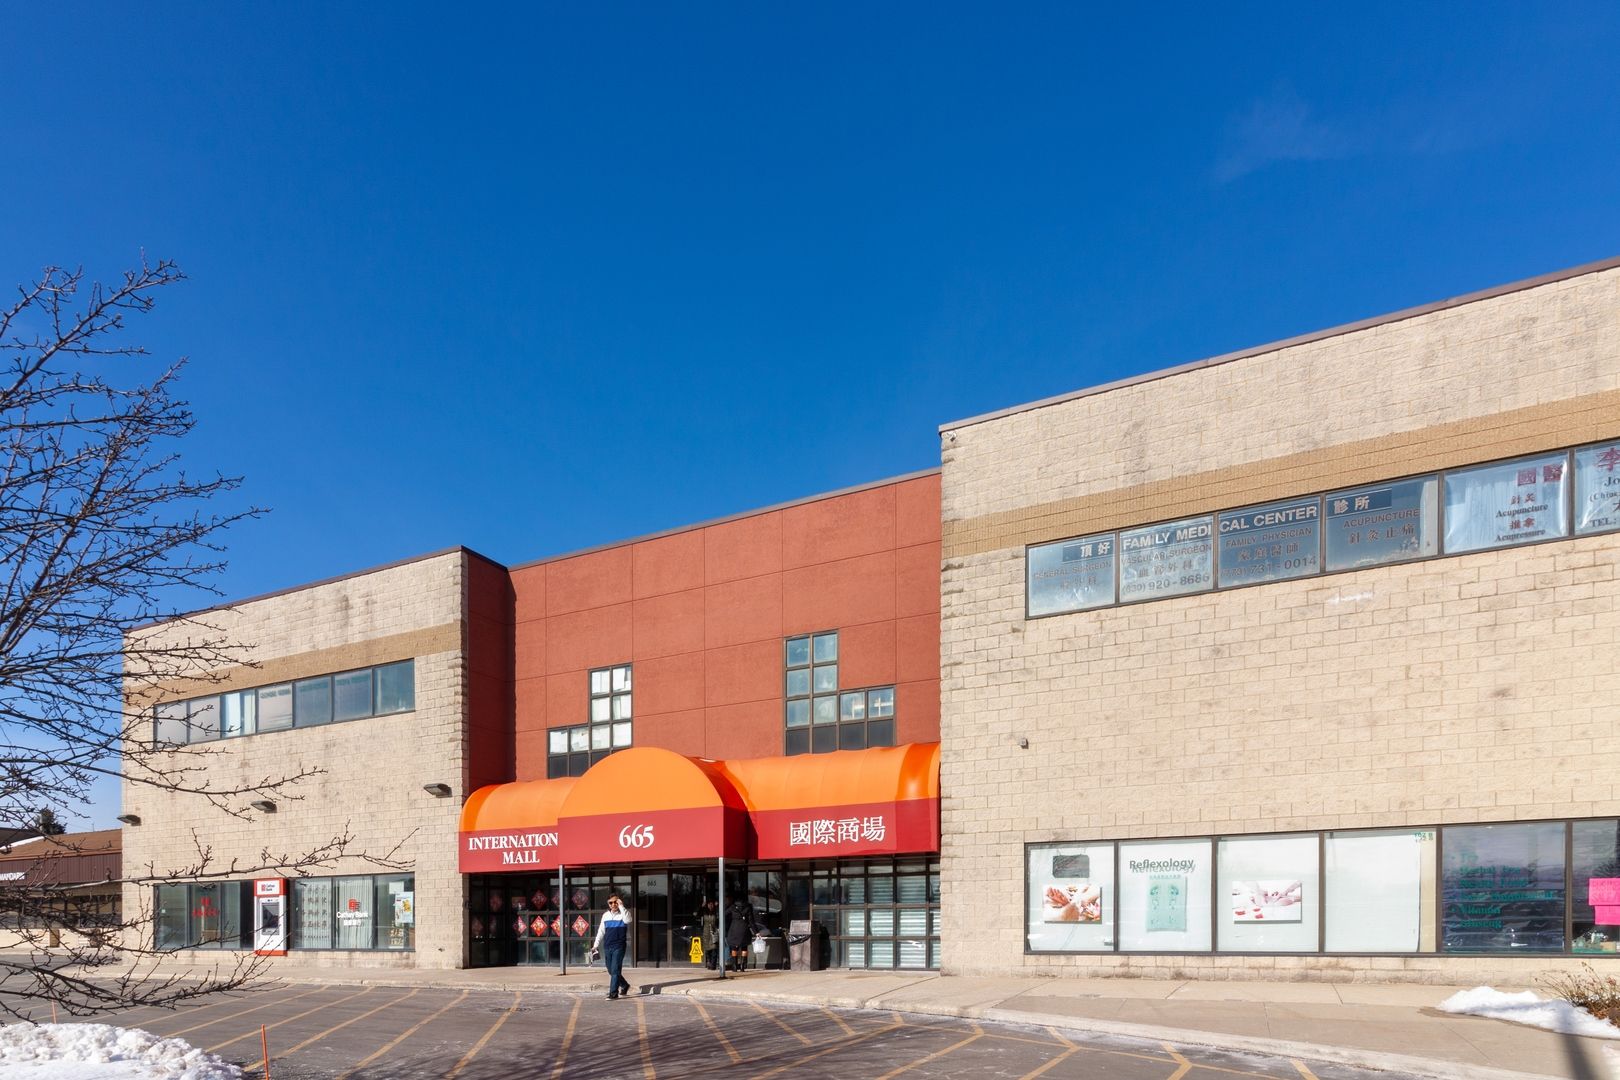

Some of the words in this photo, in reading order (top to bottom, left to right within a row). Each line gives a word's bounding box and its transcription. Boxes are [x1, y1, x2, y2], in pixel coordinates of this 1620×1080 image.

[1343, 508, 1420, 529] ACUPUNCTURE
[1496, 503, 1549, 518] Acupuncture
[1122, 532, 1170, 551] FAMILY
[1253, 505, 1317, 526] CENTER
[1495, 529, 1546, 543] Acupressure
[1225, 536, 1258, 548] FAMILY
[1262, 527, 1313, 542] PHYSICIAN
[1168, 543, 1212, 558] SURGEON
[1072, 561, 1112, 575] SURGEON
[618, 824, 655, 848] 665
[789, 815, 886, 846] 國際商場
[468, 832, 559, 850] INTERNATION
[502, 850, 540, 865] MALL
[1129, 857, 1194, 870] Reflexology
